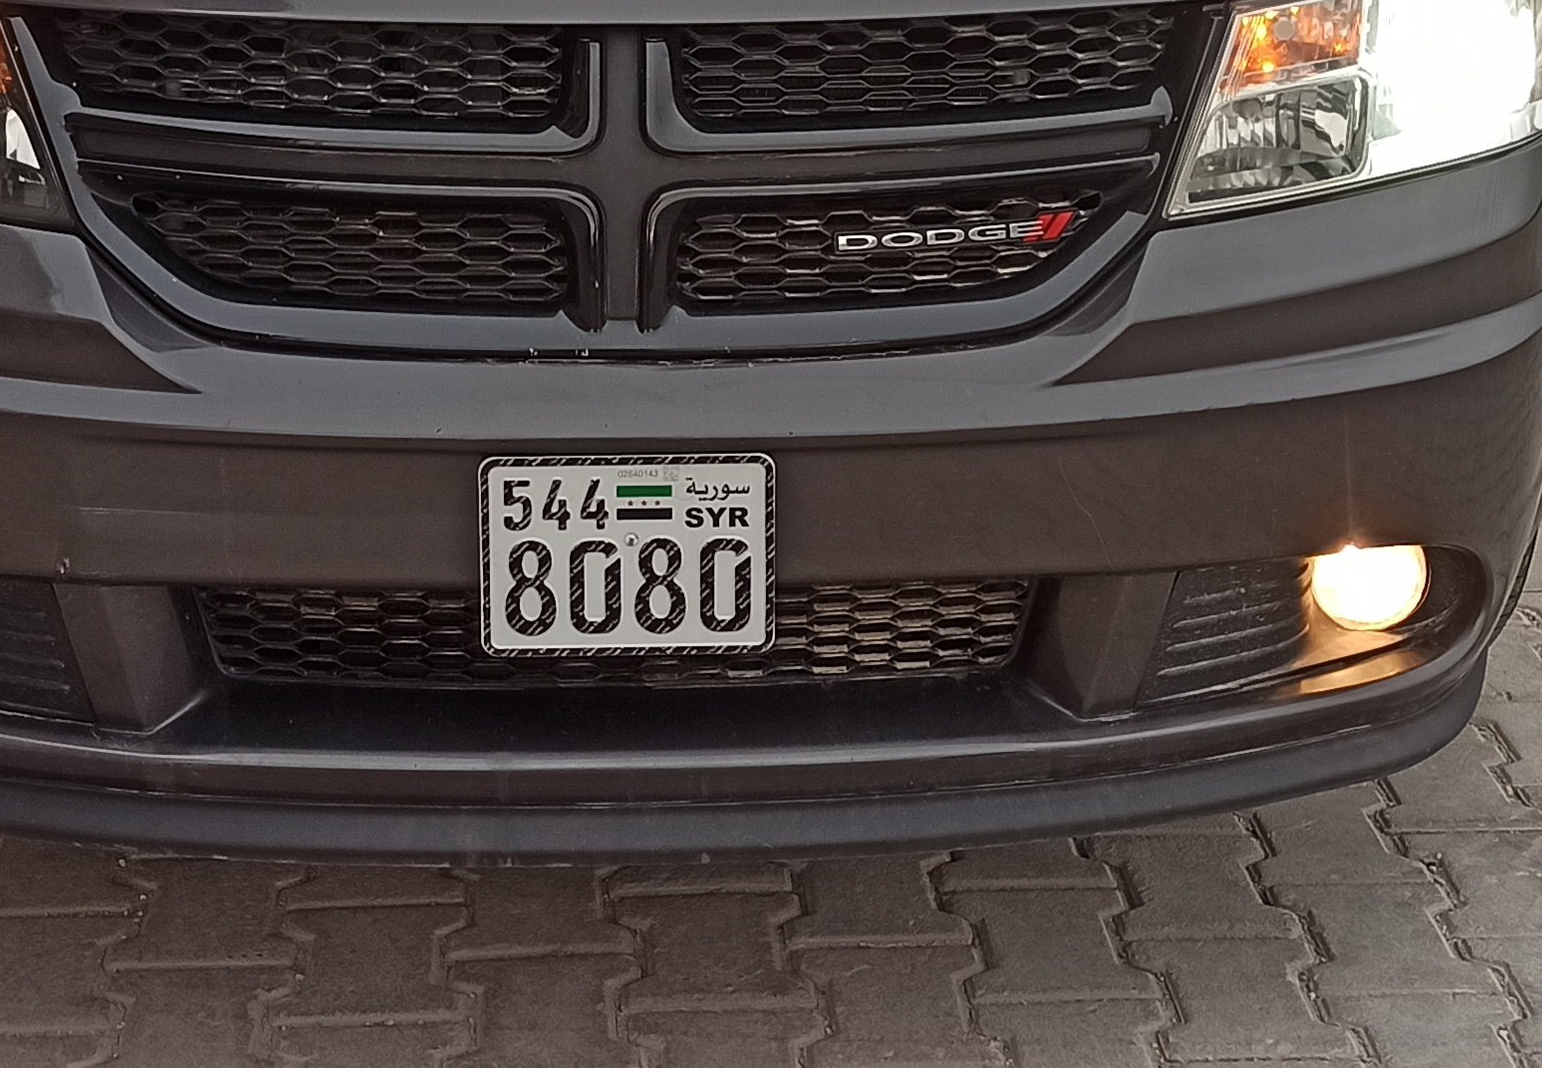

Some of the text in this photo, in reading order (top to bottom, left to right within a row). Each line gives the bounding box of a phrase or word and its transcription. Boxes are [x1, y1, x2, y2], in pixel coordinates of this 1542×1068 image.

[837, 220, 1044, 251] DODGE
[685, 477, 751, 501] سورية
[503, 479, 609, 531] 544
[684, 507, 749, 528] SYR
[505, 538, 752, 637] 8080
